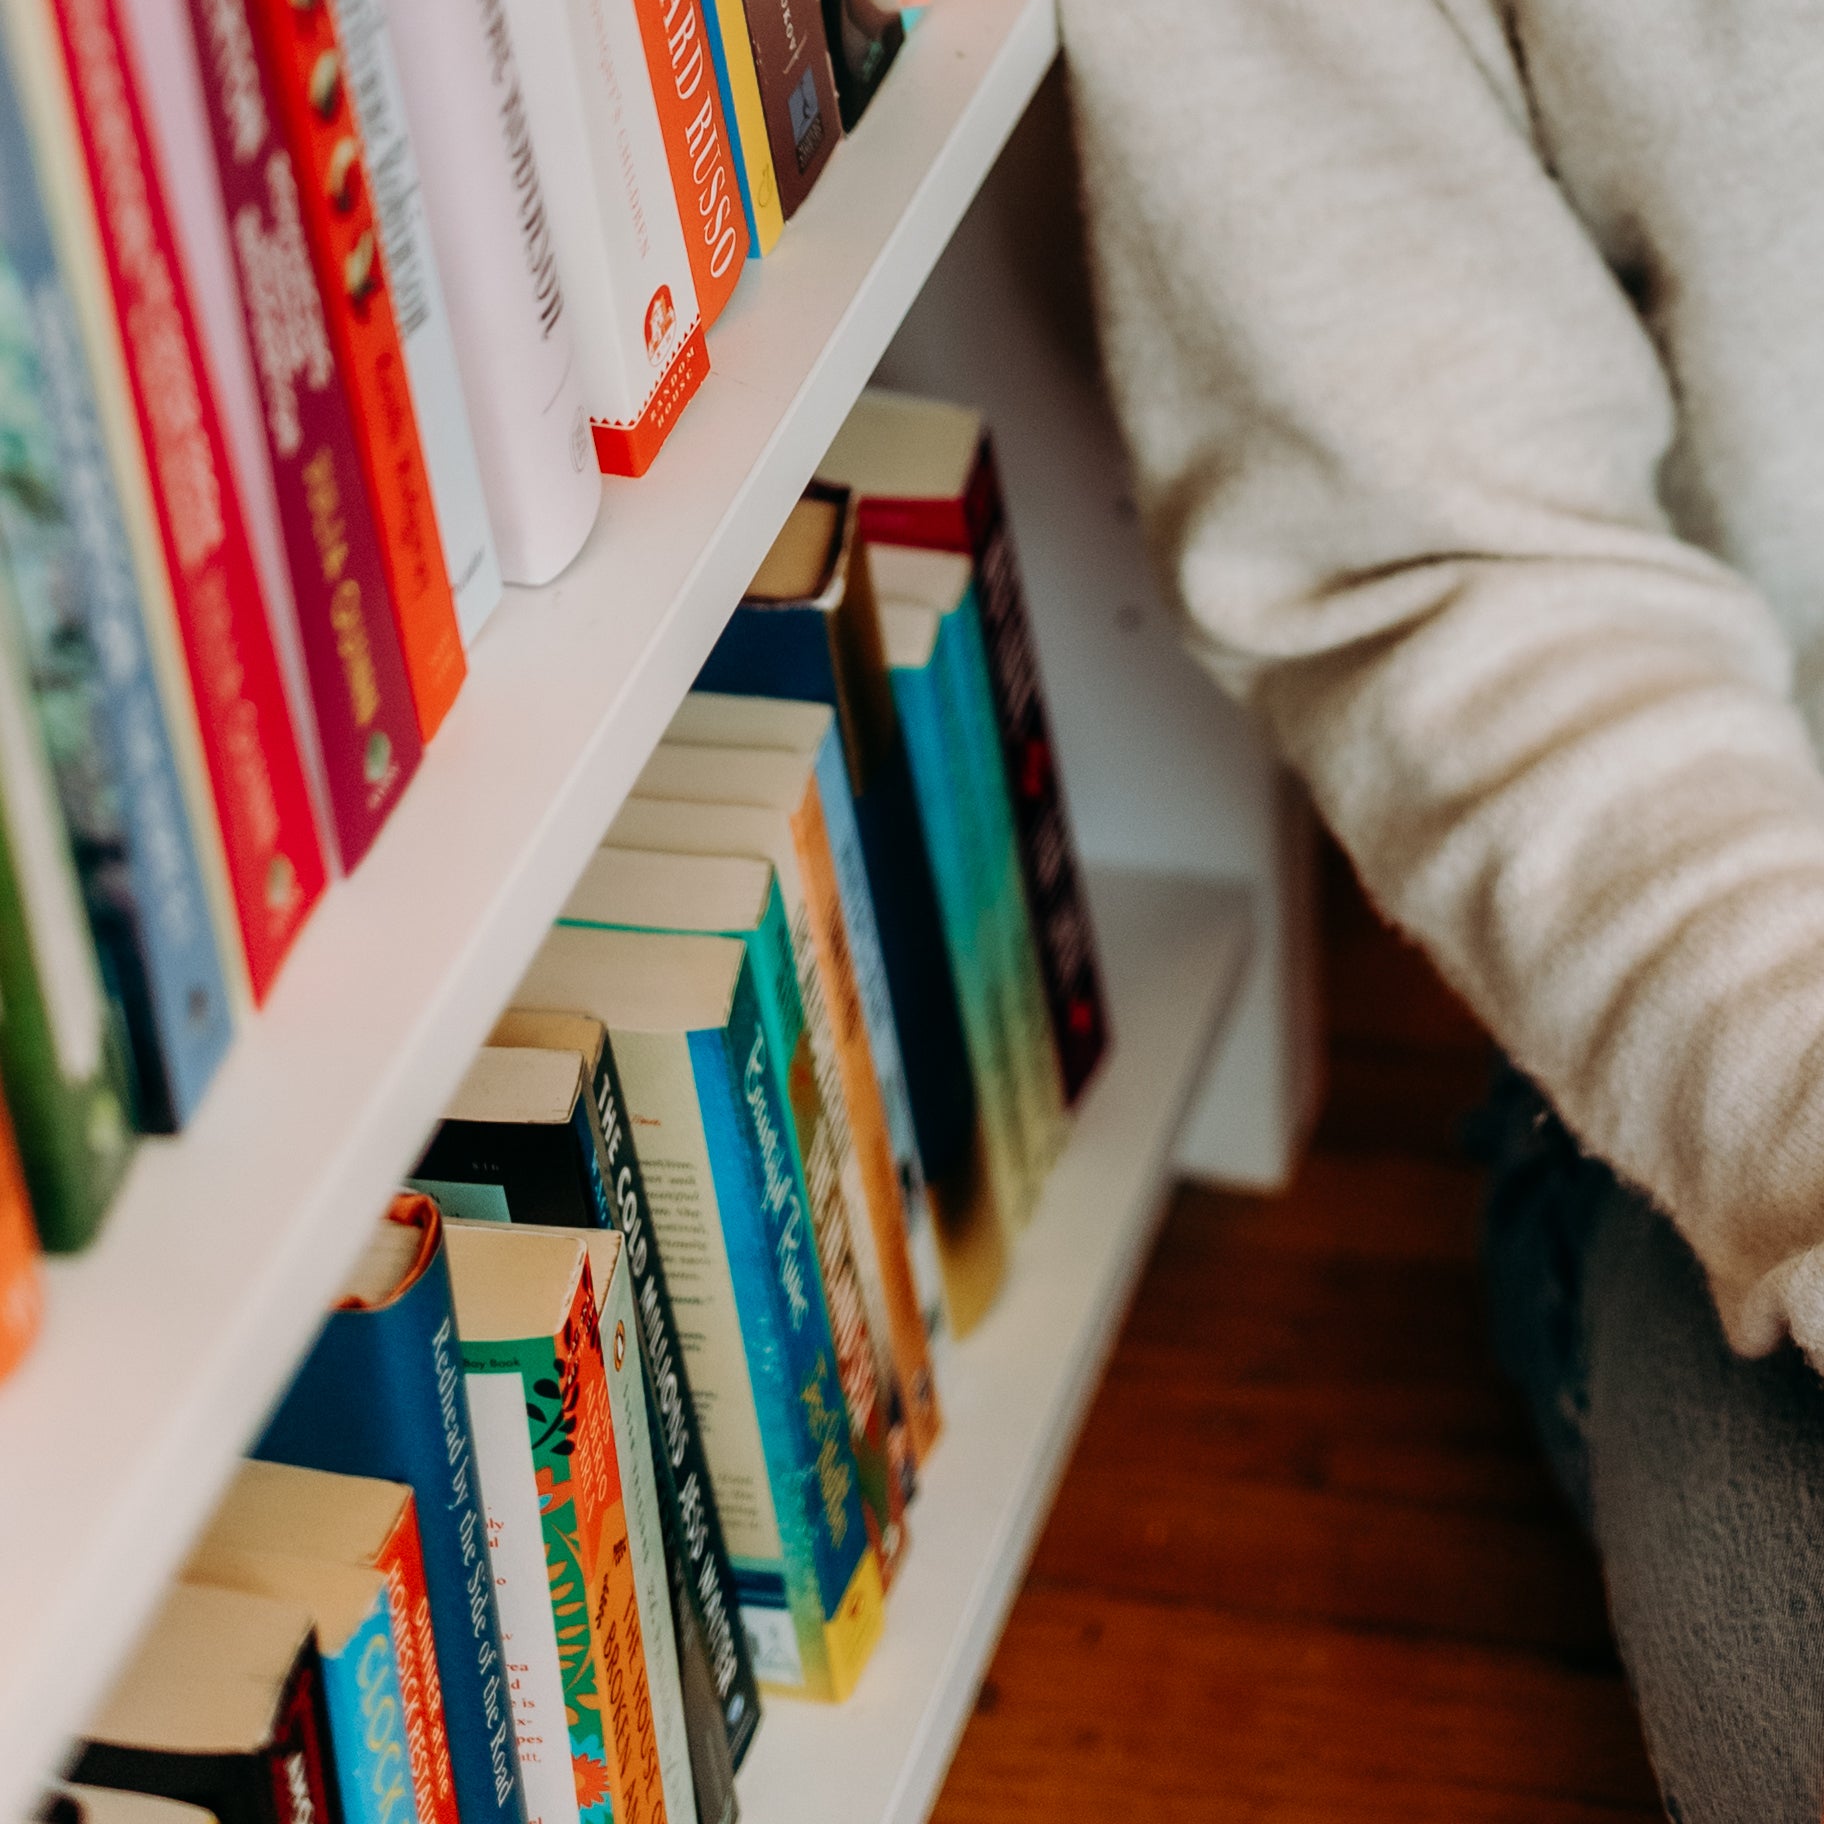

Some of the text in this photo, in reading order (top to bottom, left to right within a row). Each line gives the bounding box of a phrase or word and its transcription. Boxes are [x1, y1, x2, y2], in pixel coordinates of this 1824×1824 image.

[685, 106, 738, 282] RUSSO
[650, 346, 695, 424] RANDOM
[656, 367, 693, 429] HOUSE
[596, 1071, 622, 1166] THE
[616, 1165, 649, 1279] COLD
[638, 1274, 689, 1468] MILLIONS
[489, 1356, 521, 1369] Book
[583, 1378, 608, 1503] ALBERTO
[578, 1425, 597, 1524] URREA
[388, 1558, 424, 1723] HOMESICK
[432, 1317, 515, 1809] Redhead by the Side of the Road
[415, 1596, 443, 1714] DINNER
[433, 1746, 451, 1801] the
[602, 1619, 629, 1773] BROKEN
[623, 1584, 641, 1642] THE
[633, 1655, 656, 1793] HOUSE
